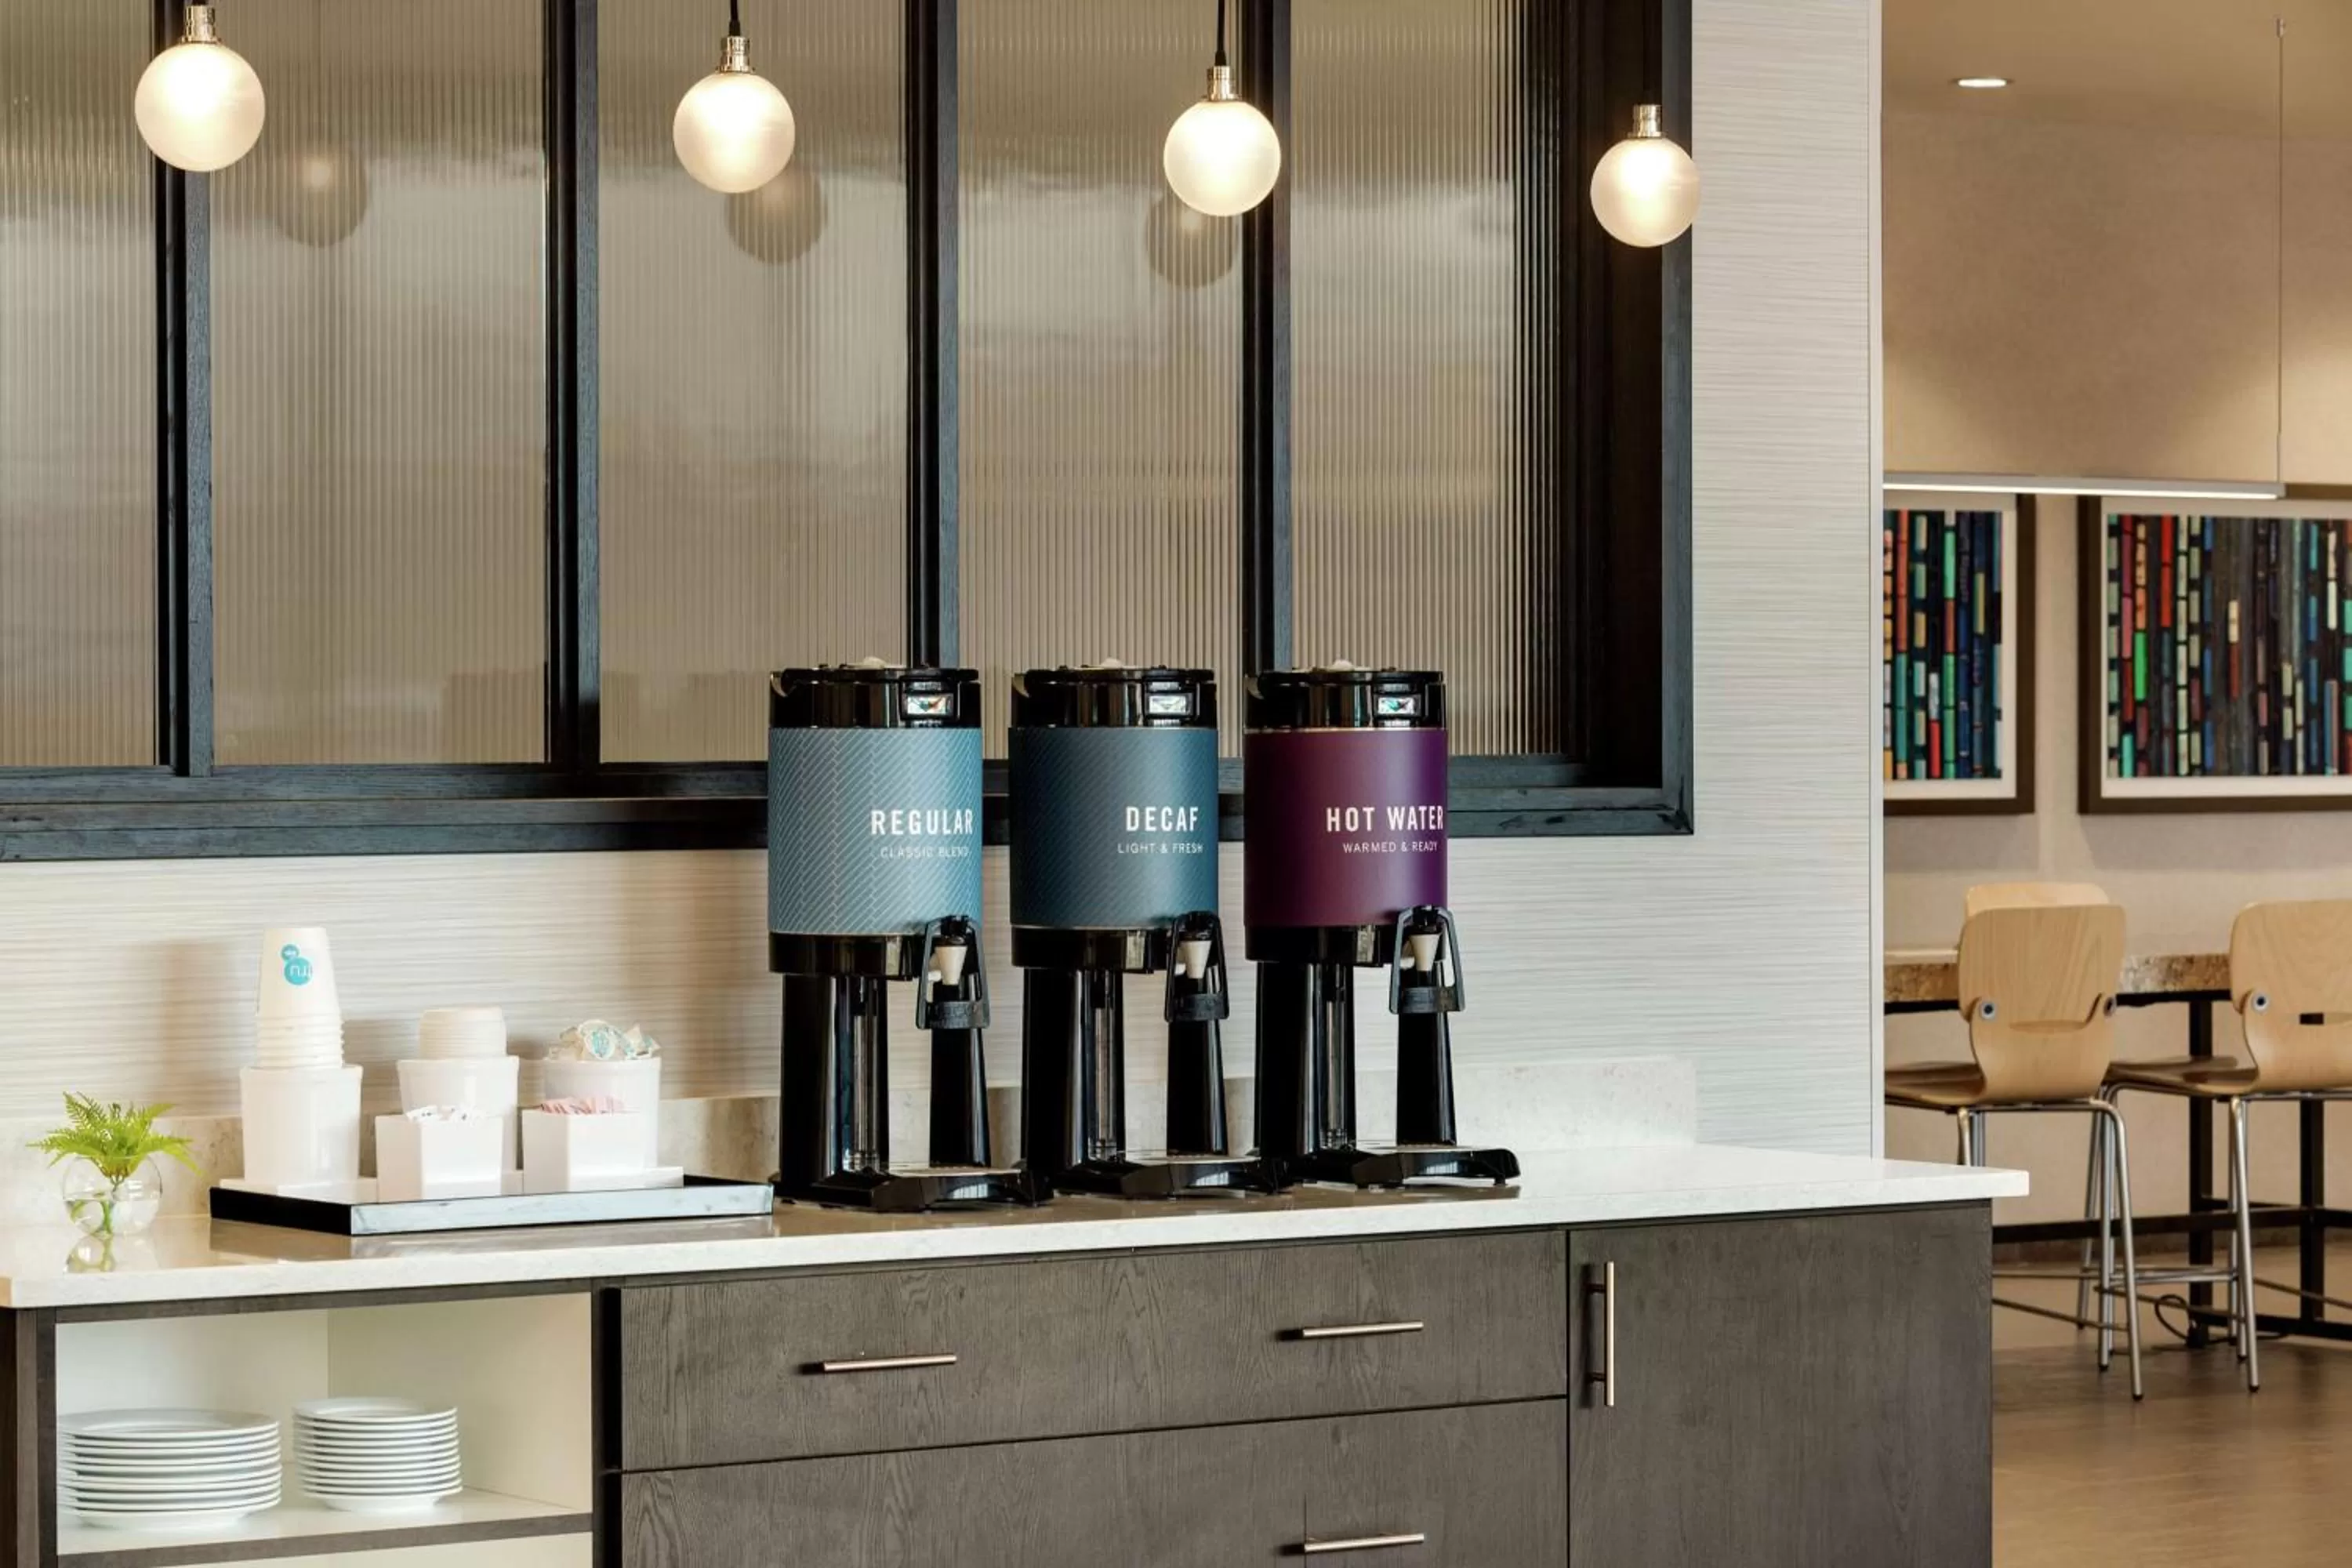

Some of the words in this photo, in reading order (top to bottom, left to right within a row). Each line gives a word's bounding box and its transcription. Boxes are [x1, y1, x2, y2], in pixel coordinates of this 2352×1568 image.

[870, 808, 974, 836] REGULAR
[1125, 806, 1199, 832] DECAF
[1326, 806, 1375, 833] HOT
[1386, 805, 1444, 831] WATER
[880, 845, 934, 859] CLASSIC
[1117, 842, 1156, 855] LIGHT
[1160, 842, 1169, 854] &
[1172, 842, 1204, 855] FRESH
[1342, 841, 1396, 854] WARMED
[1401, 840, 1407, 852] &
[1412, 840, 1439, 853] READY
